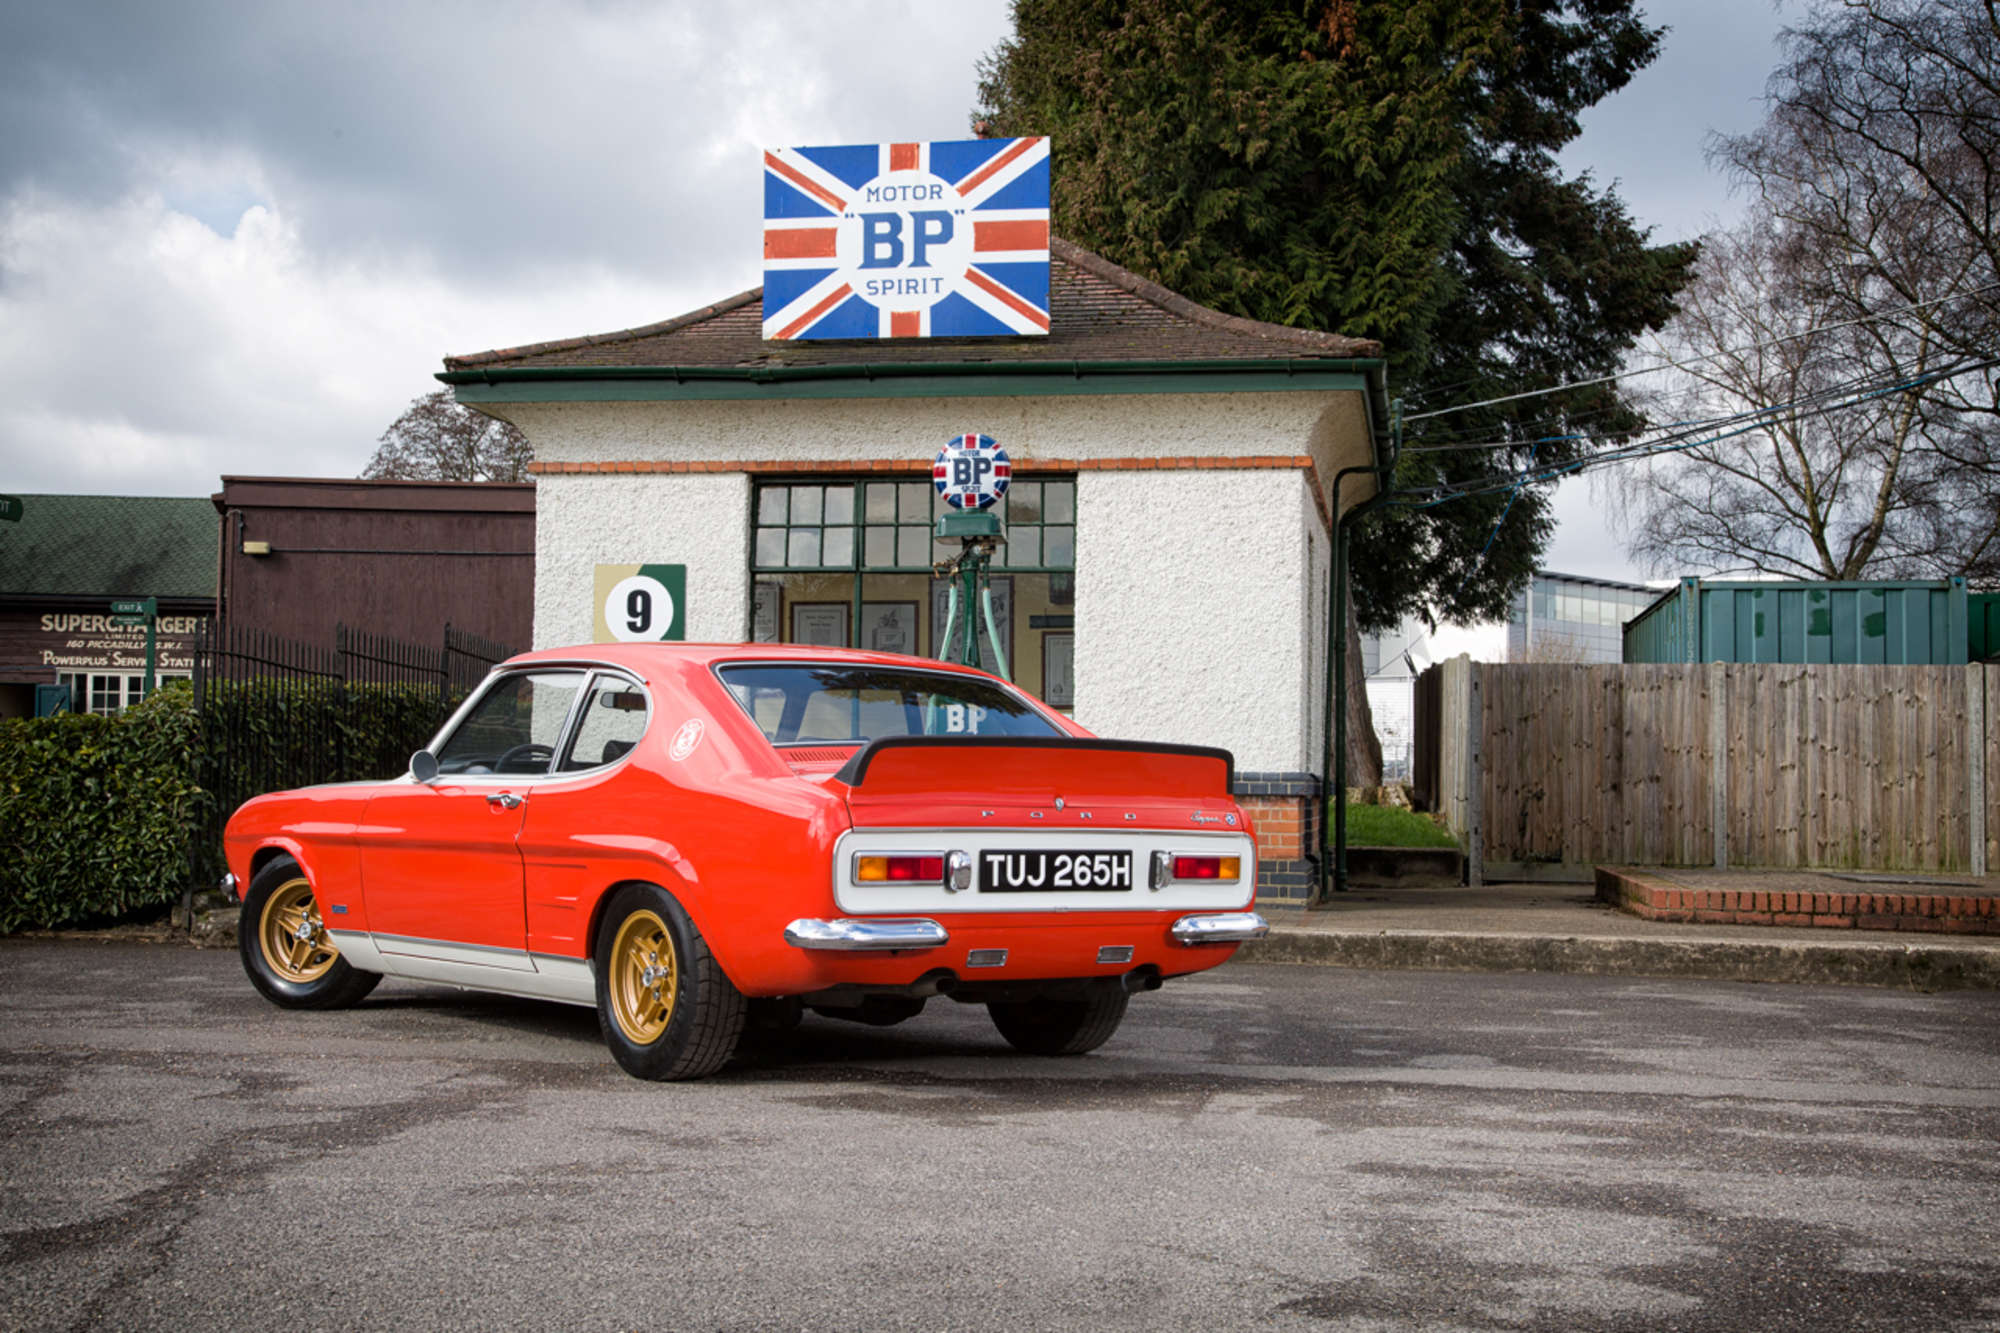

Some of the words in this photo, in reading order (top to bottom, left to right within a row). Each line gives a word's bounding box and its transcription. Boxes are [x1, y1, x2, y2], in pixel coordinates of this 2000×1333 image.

[865, 183, 943, 202] MOTOR
[865, 277, 944, 296] SPIRIT
[626, 588, 652, 634] 9
[66, 640, 84, 648] 160
[87, 640, 147, 649] PICCADILLY
[982, 810, 1137, 821] FORD
[986, 854, 1047, 887] TUJ
[1053, 854, 1131, 887] 265H
